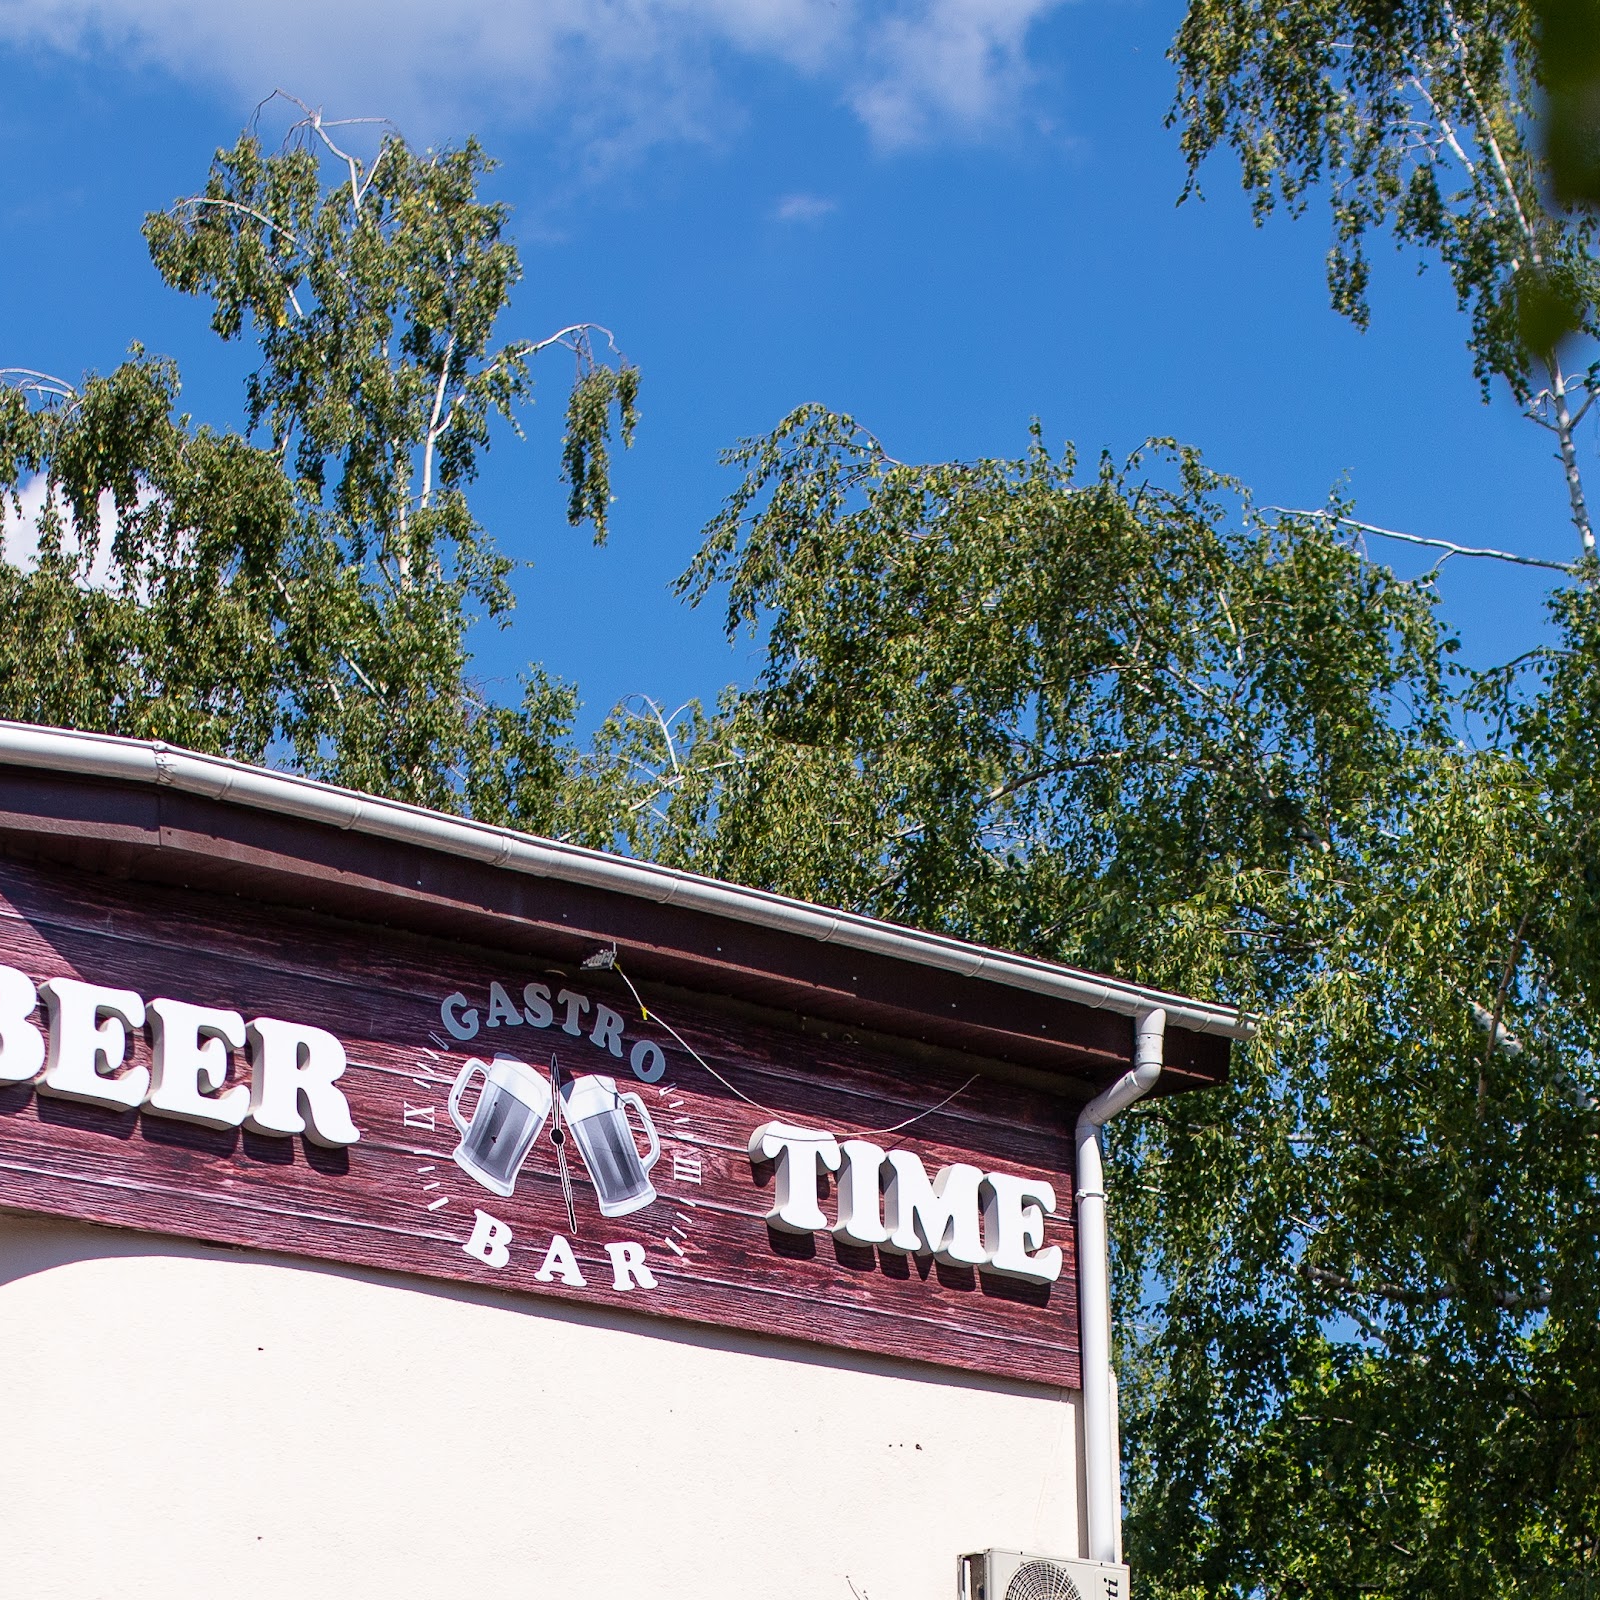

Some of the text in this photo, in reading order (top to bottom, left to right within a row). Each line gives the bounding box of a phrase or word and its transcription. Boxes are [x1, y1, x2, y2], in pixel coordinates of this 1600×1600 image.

[441, 981, 666, 1083] GASTRO
[462, 1208, 659, 1292] BAR
[748, 1119, 1063, 1284] TIME
